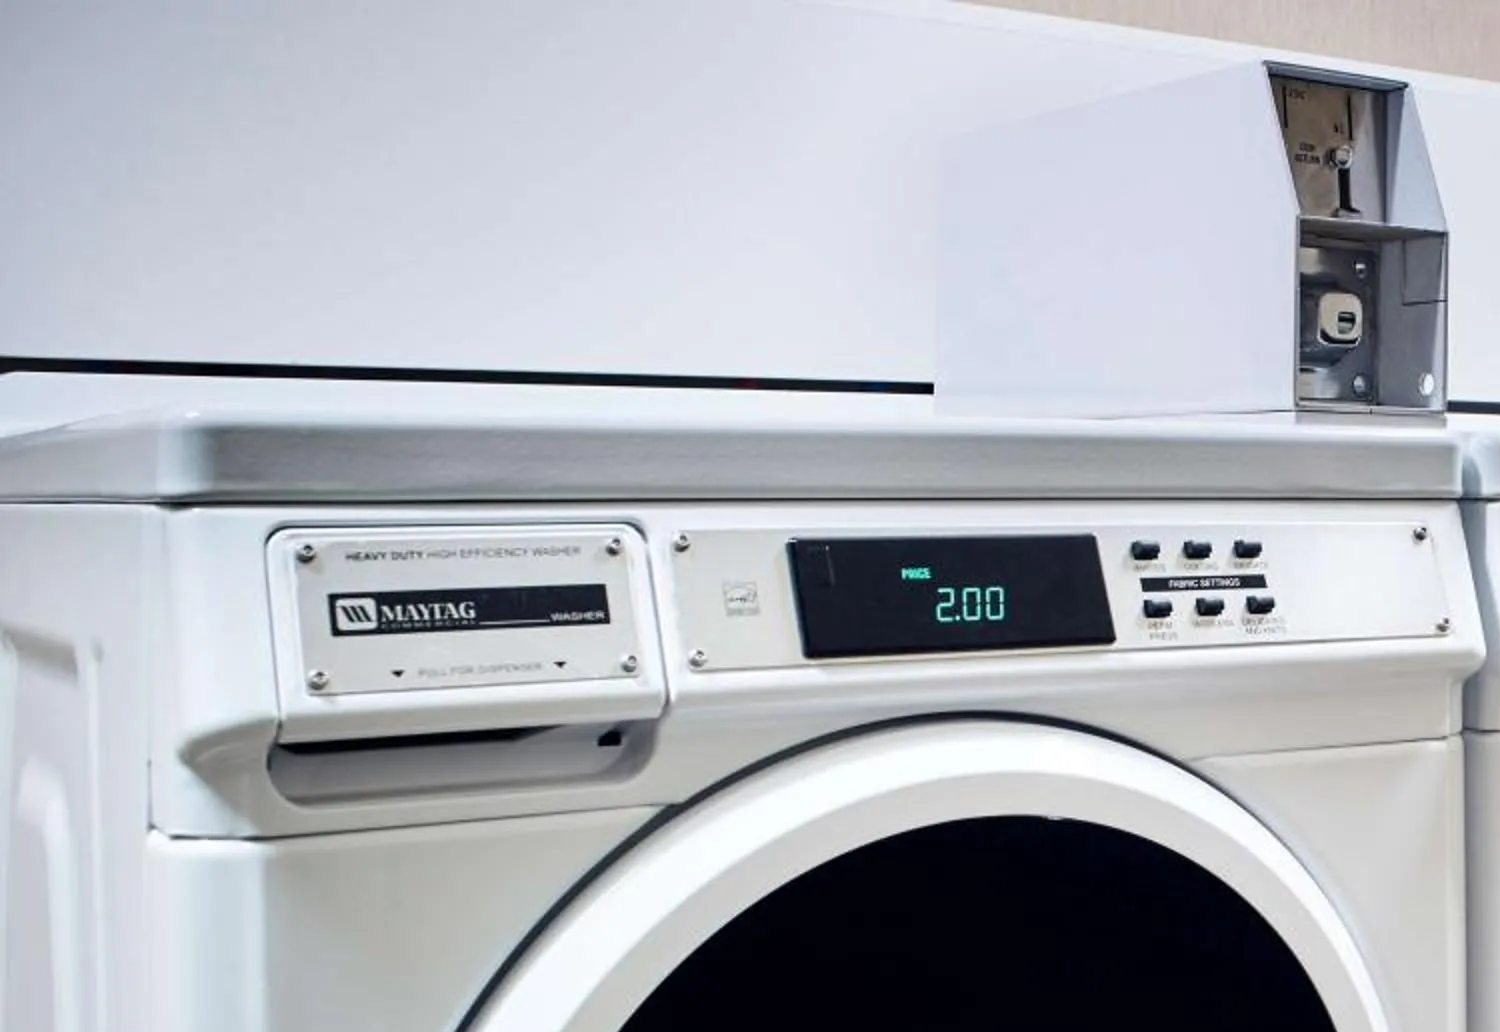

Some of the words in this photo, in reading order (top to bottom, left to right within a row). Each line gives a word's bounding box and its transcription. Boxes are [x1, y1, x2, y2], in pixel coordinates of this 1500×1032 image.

[345, 550, 386, 562] HEAVY
[391, 550, 423, 561] DUTY
[380, 601, 477, 622] MAYTAG
[936, 586, 1005, 622] 2.00
[550, 610, 605, 622] WASHER
